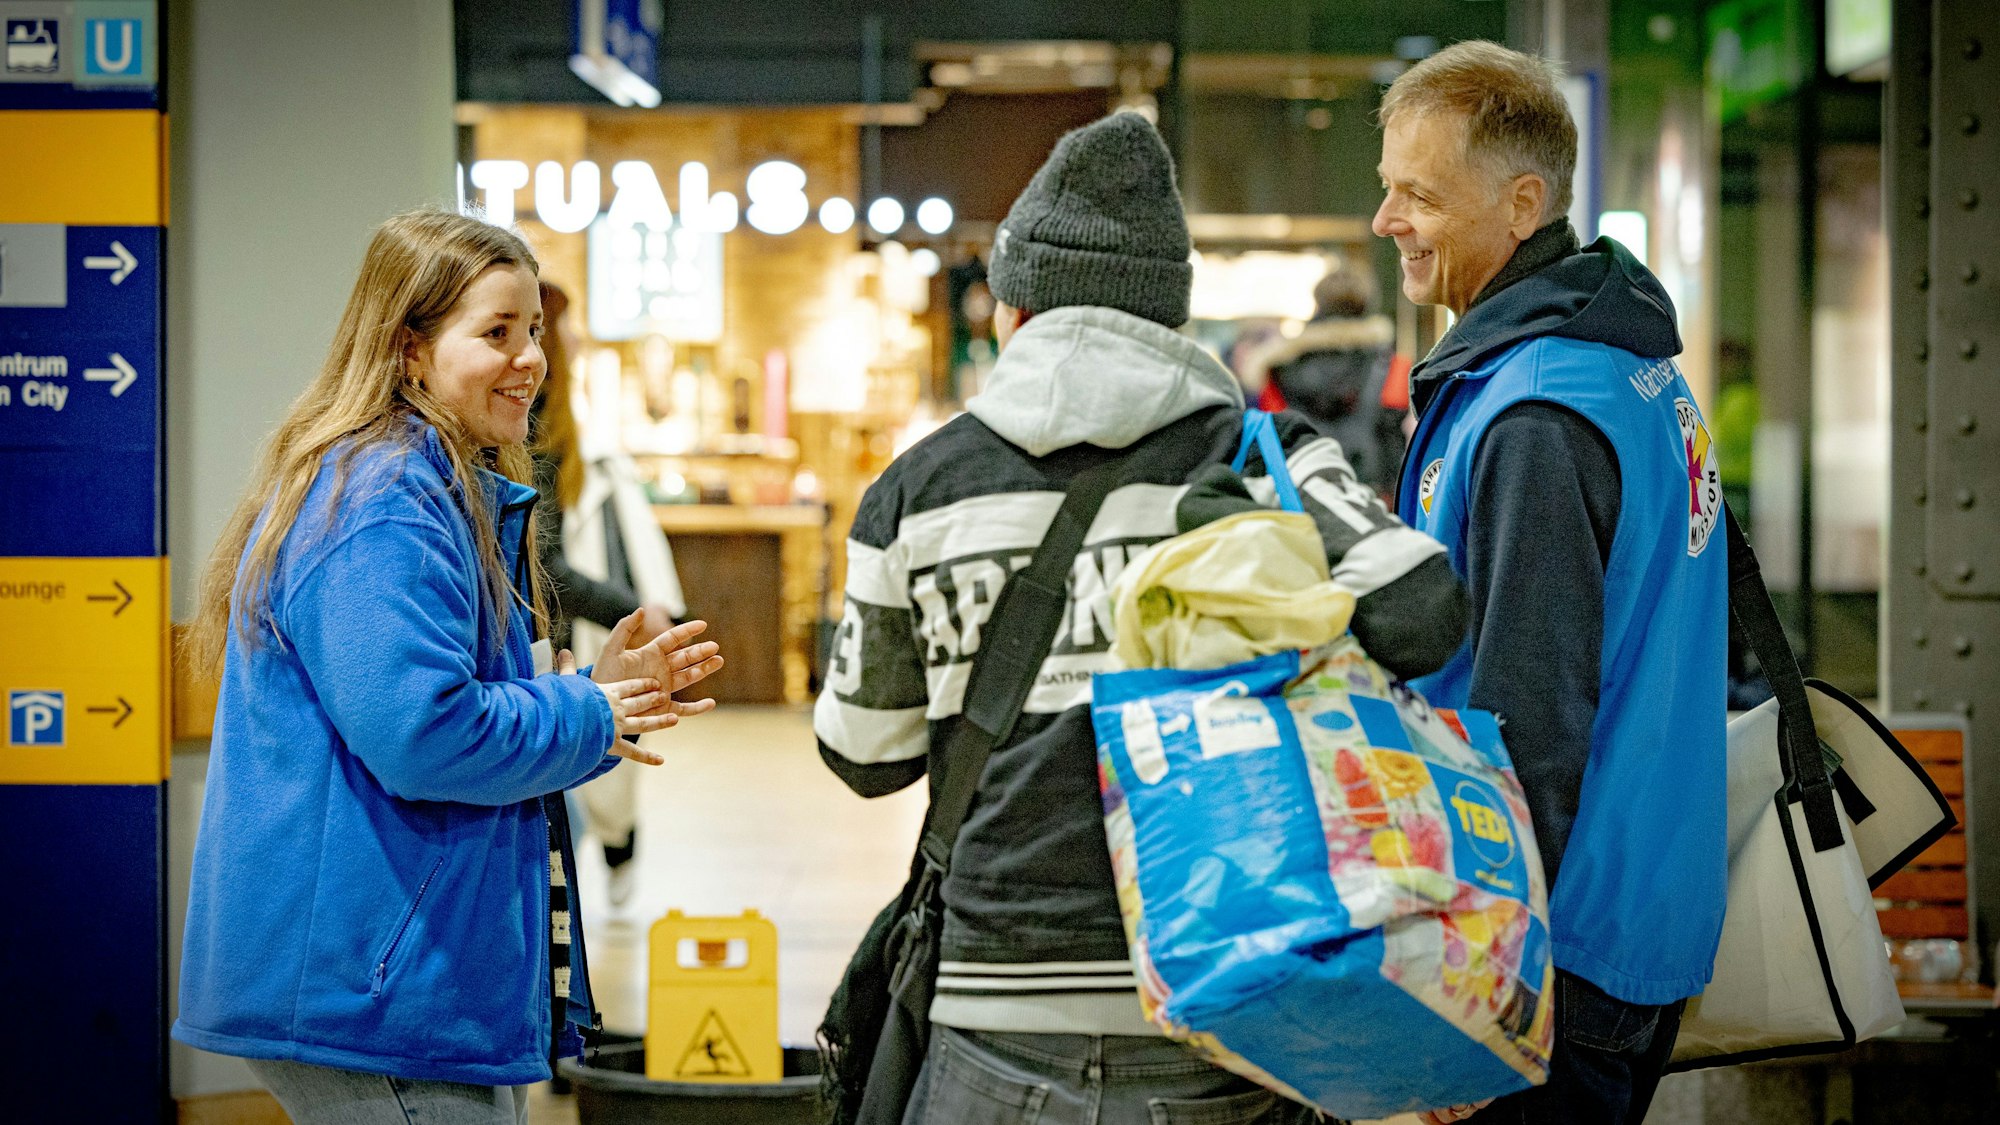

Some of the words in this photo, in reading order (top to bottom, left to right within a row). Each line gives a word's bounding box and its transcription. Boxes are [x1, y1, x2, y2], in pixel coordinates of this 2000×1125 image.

[457, 160, 954, 235] TUALS...
[0, 352, 68, 377] ntrum
[21, 380, 69, 412] City
[1690, 470, 1717, 548] MISSION
